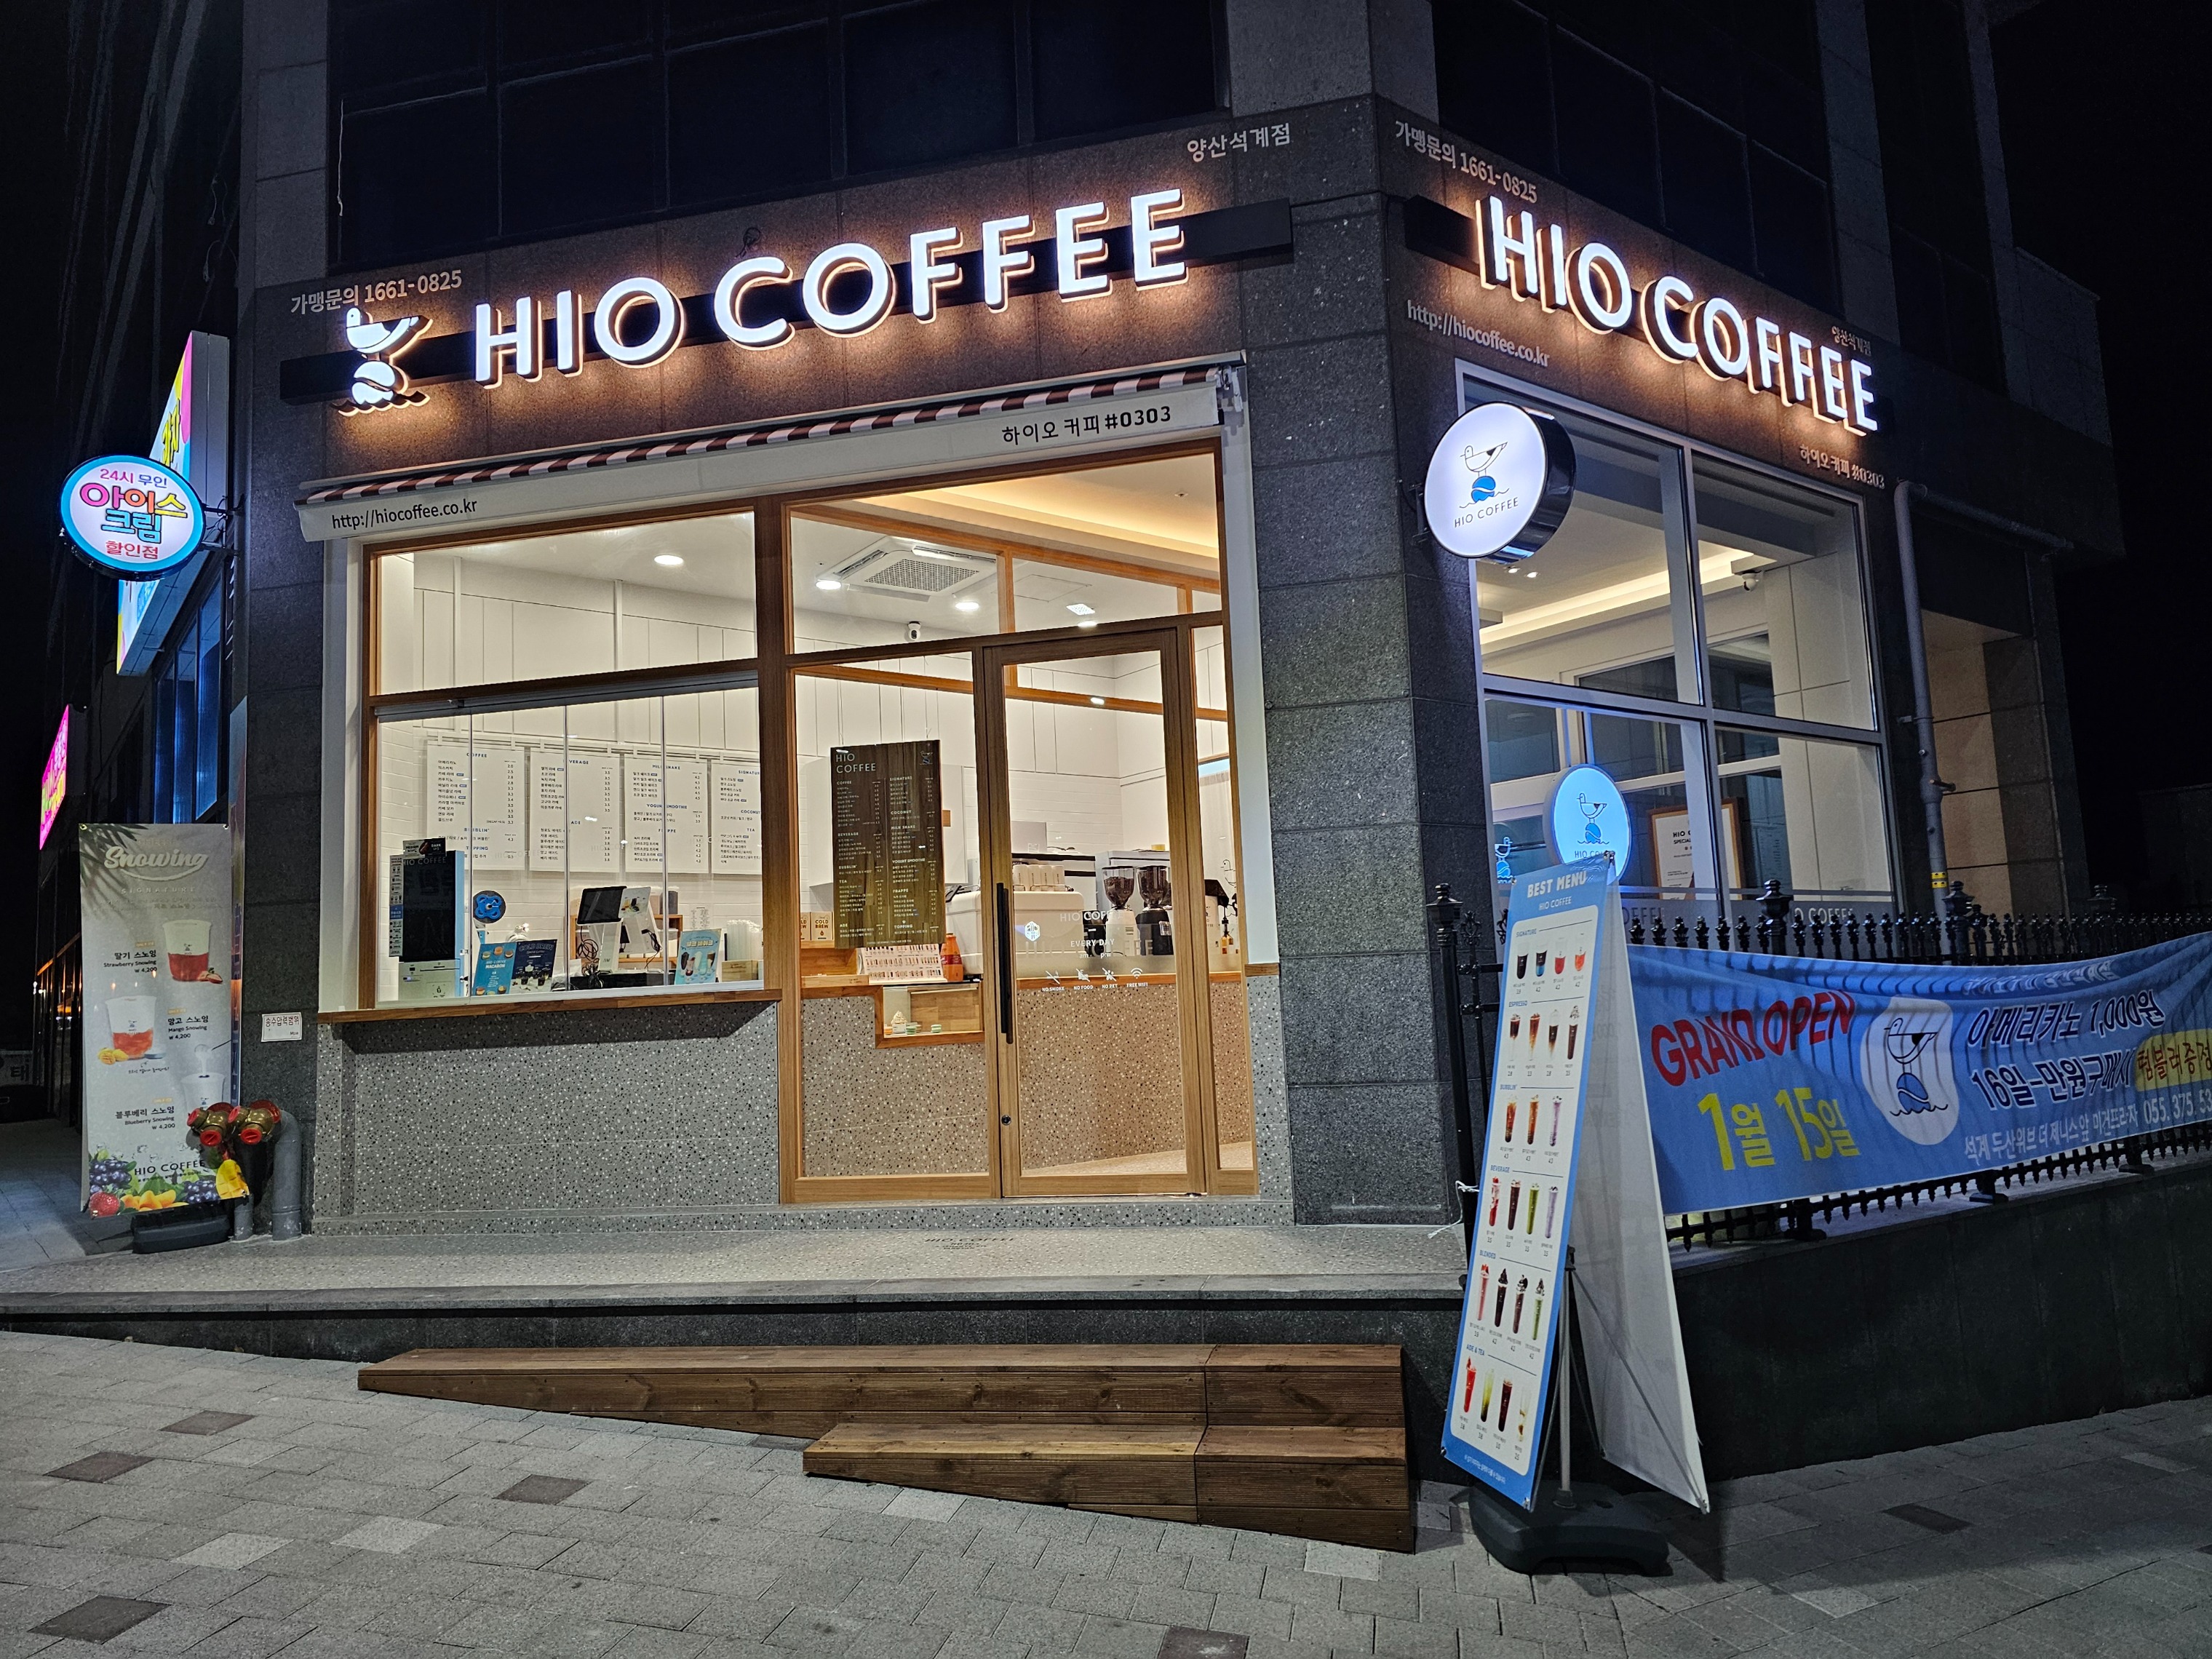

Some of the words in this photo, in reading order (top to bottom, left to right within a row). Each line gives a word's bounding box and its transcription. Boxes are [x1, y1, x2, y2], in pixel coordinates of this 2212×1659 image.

[1187, 122, 1290, 162] 양산석계점
[1396, 121, 1456, 169] 가맹문의
[1460, 152, 1537, 203] 1661-0825
[291, 285, 359, 314] 가맹문의
[365, 270, 462, 303] 1661-0825
[474, 276, 683, 386] HIO
[714, 188, 1187, 349] COFFEE
[1479, 196, 1633, 331] HIO
[1644, 276, 1877, 434] COFFEE
[1407, 300, 1550, 367] http://hiocoffee.co.kr
[100, 468, 134, 484] 24시
[138, 473, 168, 489] 무인
[79, 482, 188, 519] 아이스
[332, 498, 477, 530] http://hiocoffee.co.kr
[1455, 514, 1473, 528] HIO
[1478, 497, 1519, 519] COFFEE
[101, 508, 162, 544] 크림
[106, 541, 159, 560] 할인점
[836, 753, 855, 762] HIO
[836, 763, 876, 773] COFFEE
[104, 846, 210, 876] Snowing
[121, 886, 196, 895] SIGNATURE
[1527, 879, 1553, 899] BEST
[1556, 870, 1588, 891] MENU
[1539, 901, 1550, 911] HIO
[1550, 896, 1572, 908] COFFEE
[114, 951, 131, 960] 딸기
[133, 950, 157, 958] 스노잉
[1070, 939, 1097, 947] EVERY
[167, 1017, 183, 1026] 망고
[186, 1015, 209, 1024] 스노잉
[266, 1015, 300, 1027] 송수압력범위
[1968, 1002, 2081, 1049] 아메리카노
[2090, 989, 2165, 1038] 1,000원
[175, 1033, 191, 1041] 4,200
[1651, 1008, 1765, 1086] GRAND
[1762, 990, 1855, 1056] OPEN
[115, 1108, 148, 1119] 블루베리
[151, 1106, 175, 1115] 스노잉
[1698, 1093, 1775, 1171] 1월
[1774, 1087, 1860, 1161] 15일
[1965, 1135, 1991, 1166] 석계
[134, 1166, 156, 1176] HIO
[160, 1159, 206, 1172] COFFEE
